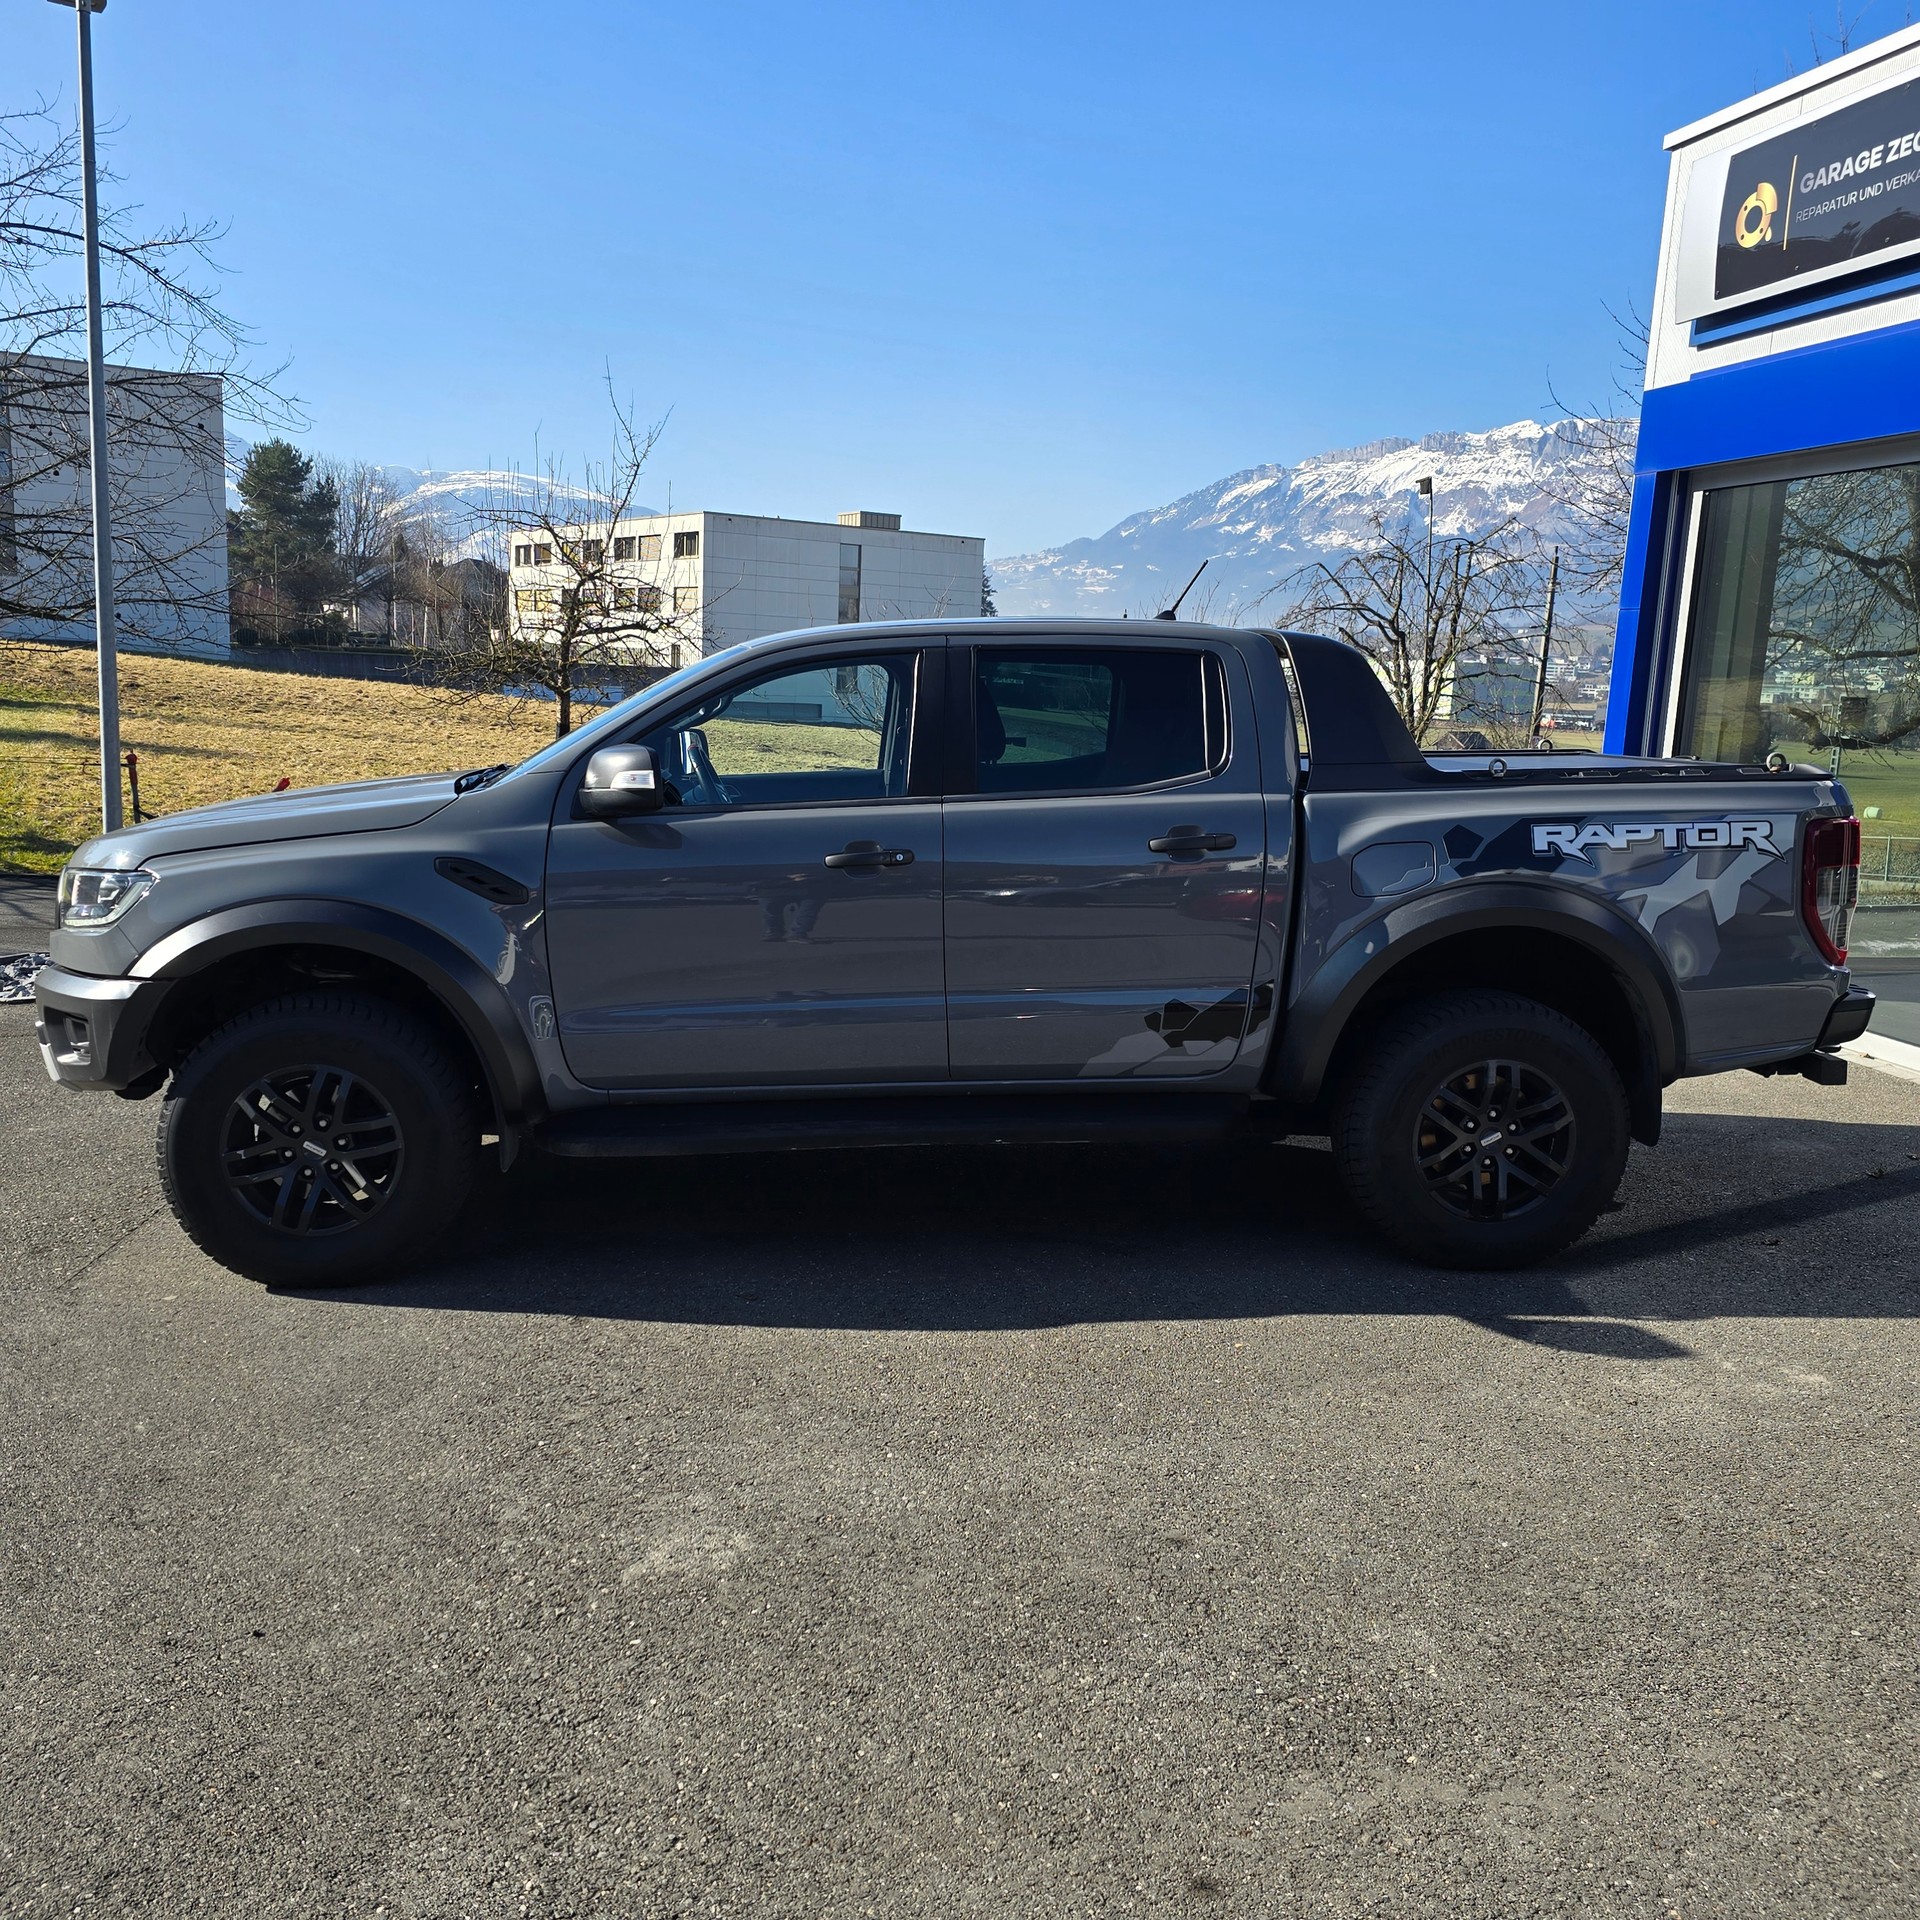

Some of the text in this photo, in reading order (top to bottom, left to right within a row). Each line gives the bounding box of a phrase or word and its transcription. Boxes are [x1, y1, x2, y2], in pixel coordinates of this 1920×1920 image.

[1800, 144, 1884, 193] GARAGE
[1796, 191, 1858, 223] REPARATUR
[1860, 182, 1884, 201] UND
[1532, 821, 1786, 868] RAPTOR
